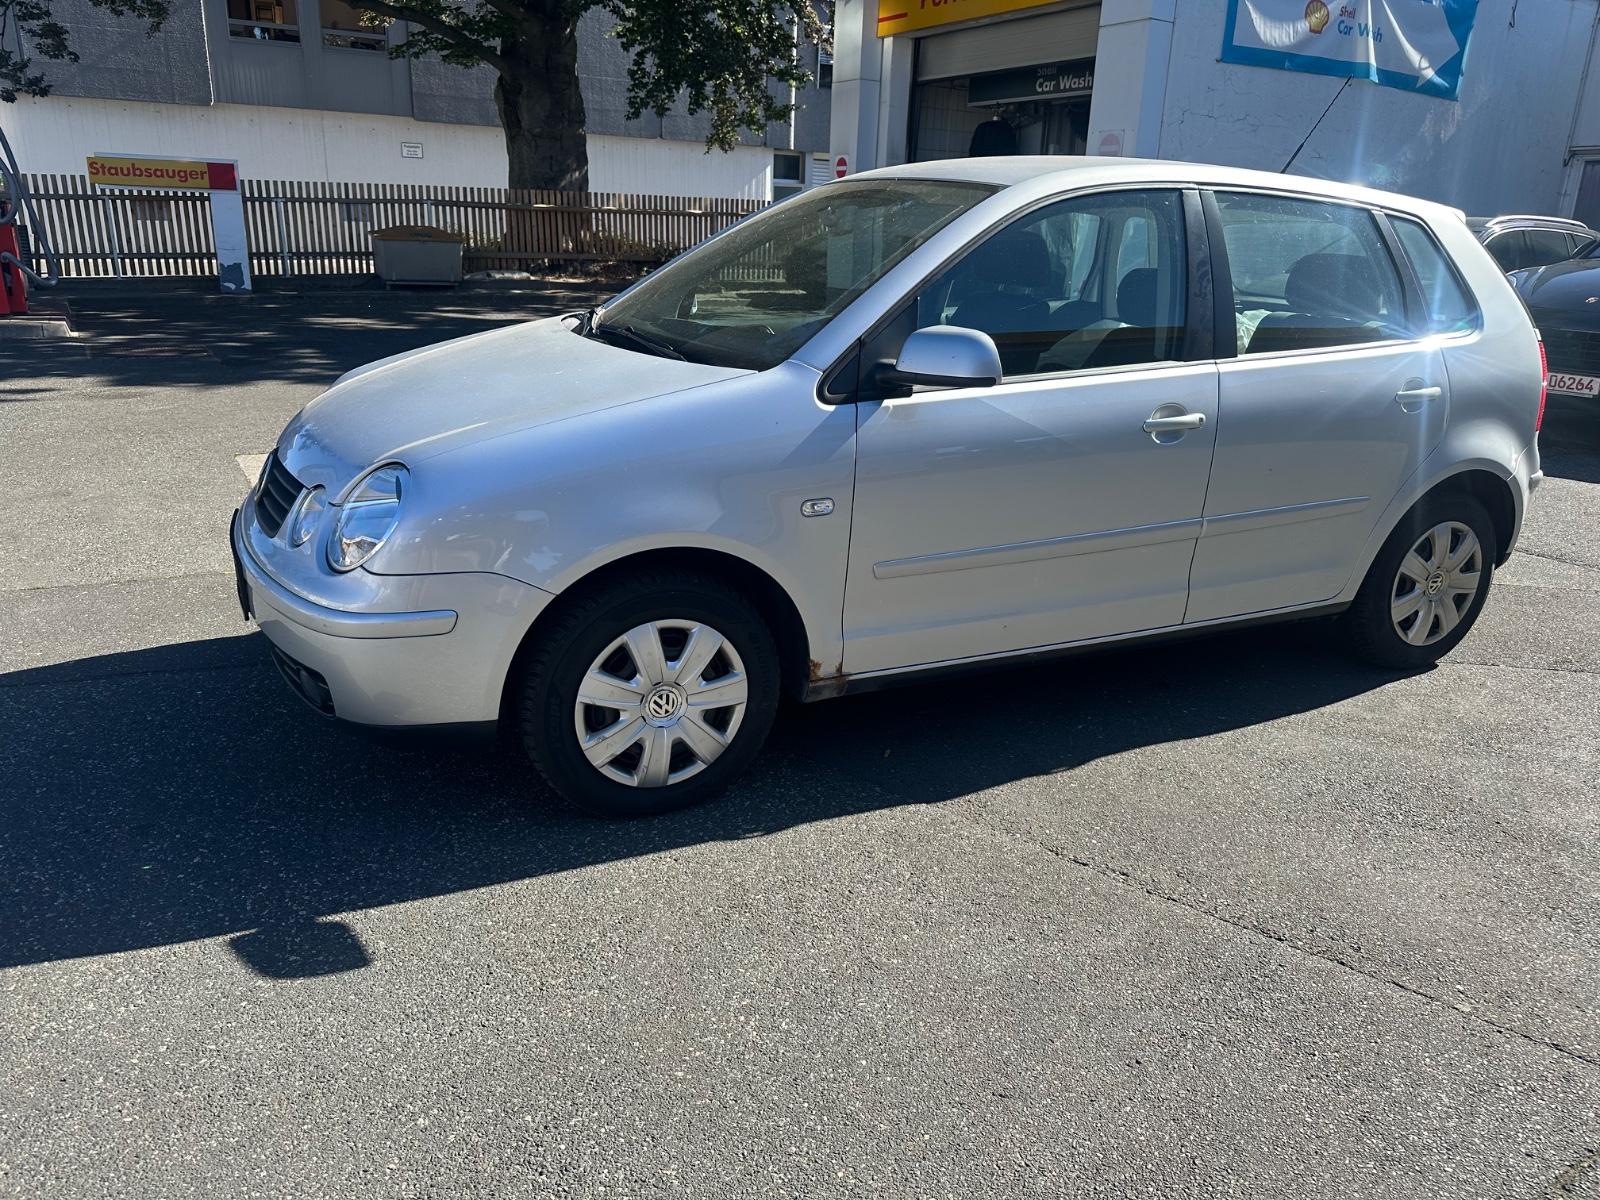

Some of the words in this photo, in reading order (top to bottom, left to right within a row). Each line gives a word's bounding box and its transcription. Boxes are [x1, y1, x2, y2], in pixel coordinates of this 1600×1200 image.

[1339, 6, 1357, 19] Shell
[1337, 20, 1353, 36] Car
[1358, 22, 1383, 42] Wsh
[1035, 77, 1056, 92] Car
[1059, 71, 1093, 90] Wash
[88, 160, 208, 183] Staubsauger
[1548, 374, 1594, 392] 06264
